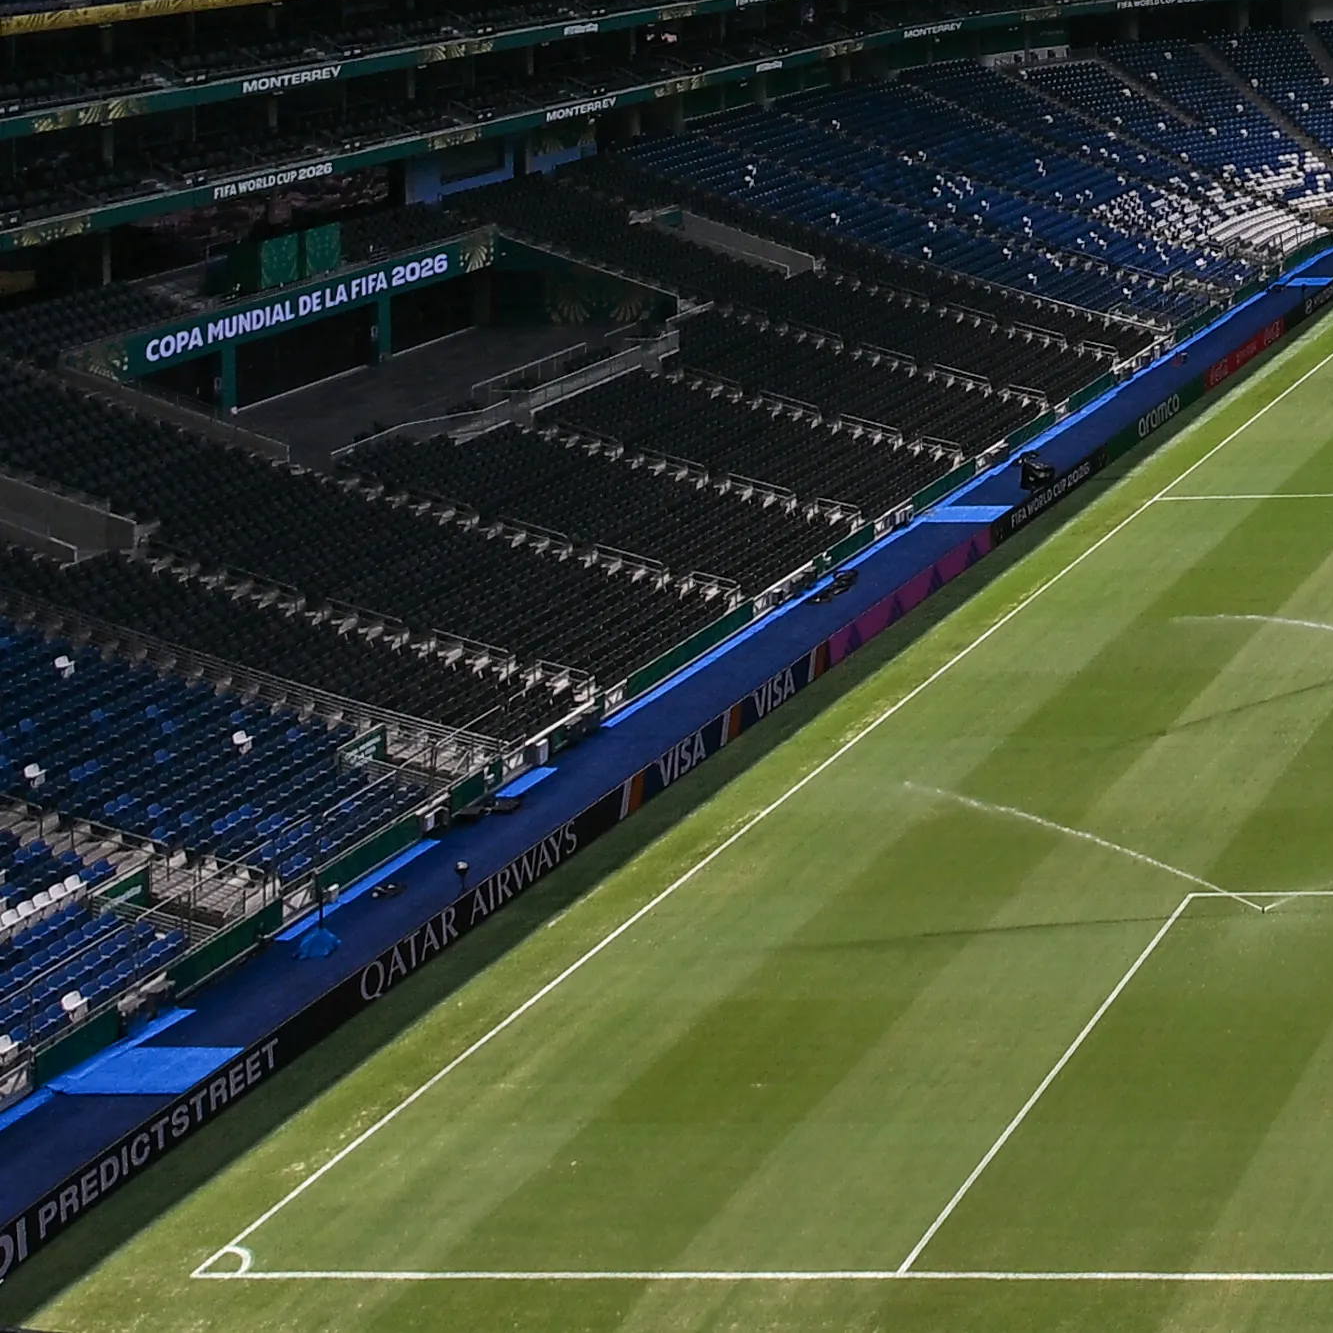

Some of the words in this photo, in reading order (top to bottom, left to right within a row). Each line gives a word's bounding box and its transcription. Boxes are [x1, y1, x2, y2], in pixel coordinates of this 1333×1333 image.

[242, 65, 342, 94] MONTERREY
[545, 97, 617, 122] MONTERREY
[213, 183, 238, 200] FIFA
[237, 174, 276, 197] WORLD
[276, 169, 298, 187] CUP
[298, 162, 333, 181] 2026
[145, 326, 203, 363] COPA
[207, 299, 296, 345] MUNDIAL
[299, 290, 322, 317] DE
[324, 284, 350, 309] LA
[351, 270, 388, 300] FIFA
[390, 253, 449, 288] 2026
[1138, 393, 1180, 438] aramco
[1011, 510, 1028, 529] FIFA
[1027, 489, 1053, 517] WORLD
[1052, 480, 1067, 498] CUP
[1067, 462, 1091, 488] 2026
[753, 667, 796, 719] VISA
[657, 729, 707, 787] VISA
[360, 906, 459, 1001] QATAR
[470, 821, 578, 926] AIRWAYS
[38, 1038, 279, 1240] PREDICTSTREET
